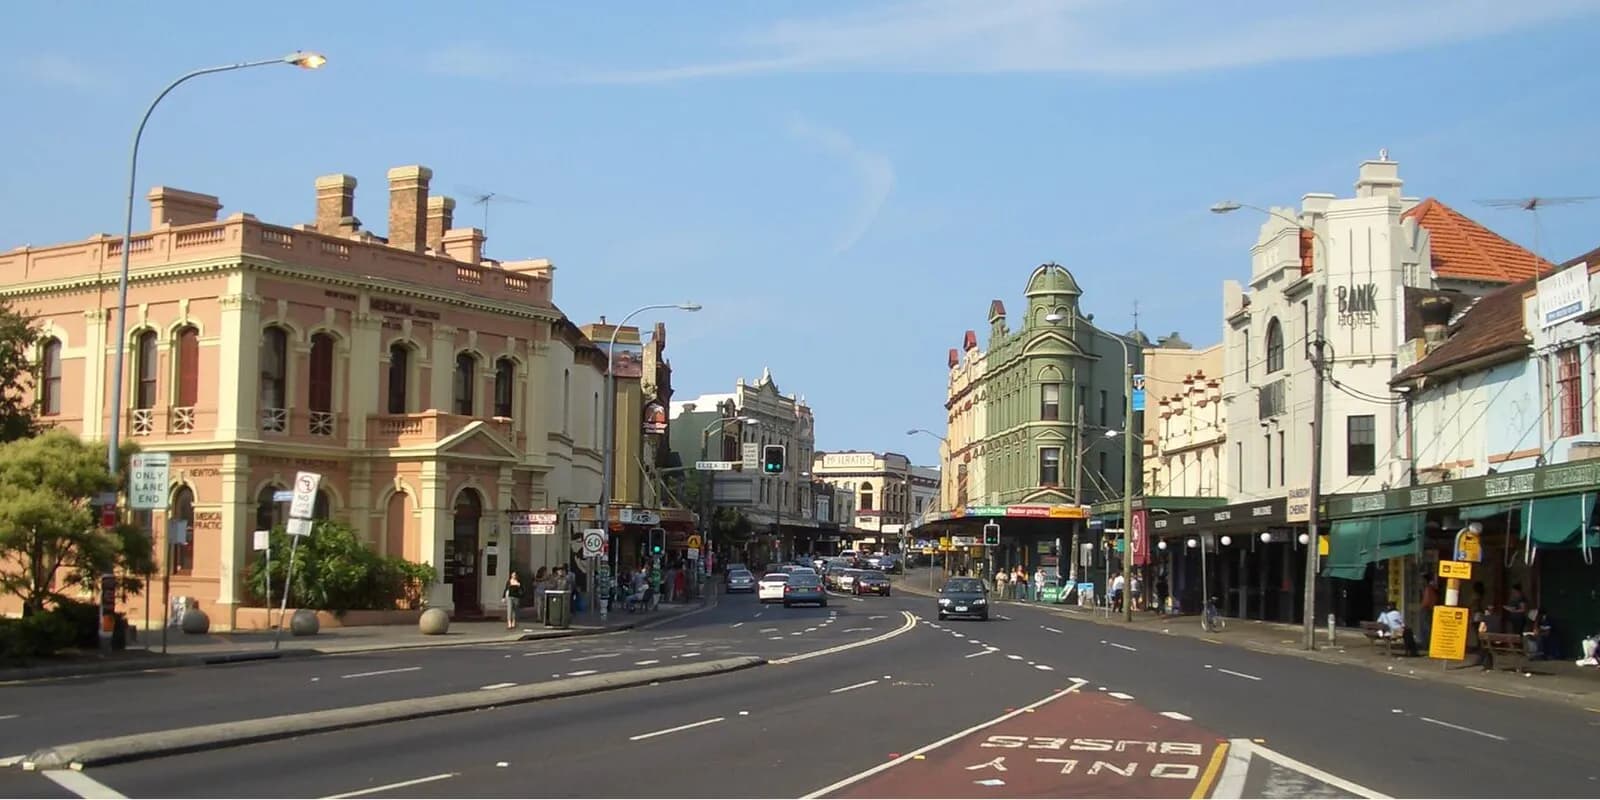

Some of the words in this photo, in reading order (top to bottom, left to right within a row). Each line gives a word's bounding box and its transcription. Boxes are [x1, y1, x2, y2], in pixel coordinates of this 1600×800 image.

[1337, 283, 1377, 312] BANK
[1337, 311, 1378, 326] HOTEL
[135, 471, 164, 480] ONLY
[135, 483, 163, 492] LANE
[138, 494, 160, 503] END
[587, 537, 600, 547] 60
[980, 735, 1202, 755] BUSES
[965, 756, 1199, 779] ONLY
